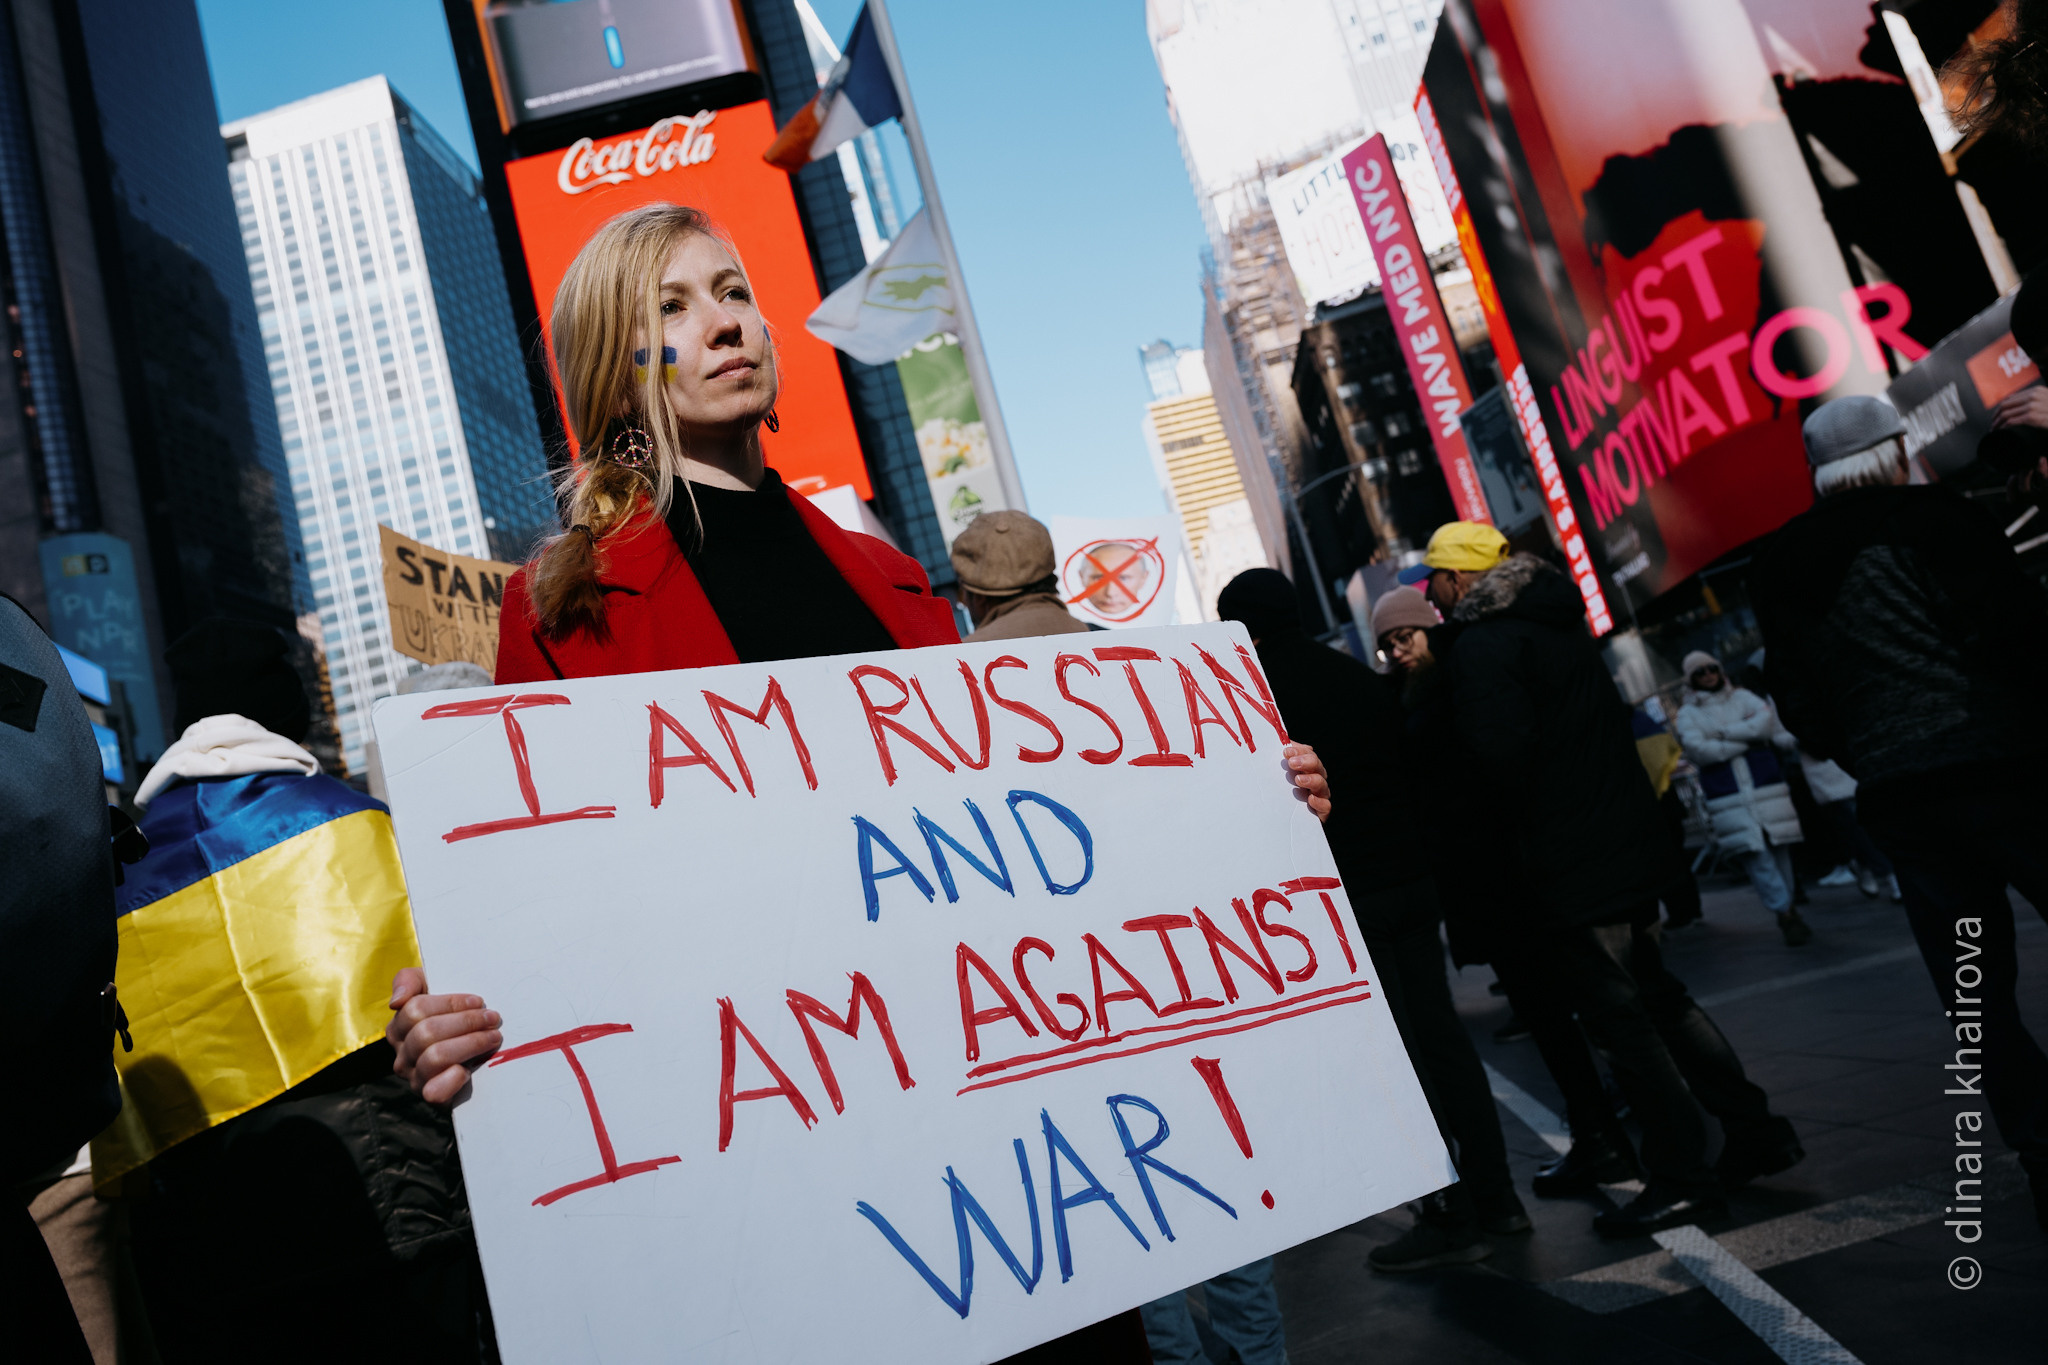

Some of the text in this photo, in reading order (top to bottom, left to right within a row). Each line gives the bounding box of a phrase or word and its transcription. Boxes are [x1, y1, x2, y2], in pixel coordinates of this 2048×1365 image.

[558, 109, 717, 194] Coca-Cola
[1292, 162, 1346, 215] LITTL
[1355, 158, 1462, 438] WAVE MED NYC
[1550, 227, 1724, 450] LINGUIST
[1578, 281, 1929, 530] MOTIVATOR
[396, 545, 509, 608] STAN
[1566, 533, 1615, 638] STORE
[420, 640, 1292, 843] I AM RUSSIAN
[850, 788, 1095, 923] AND
[488, 875, 1357, 1207] I AM AGAINST
[856, 1055, 1275, 1320] WAR!
